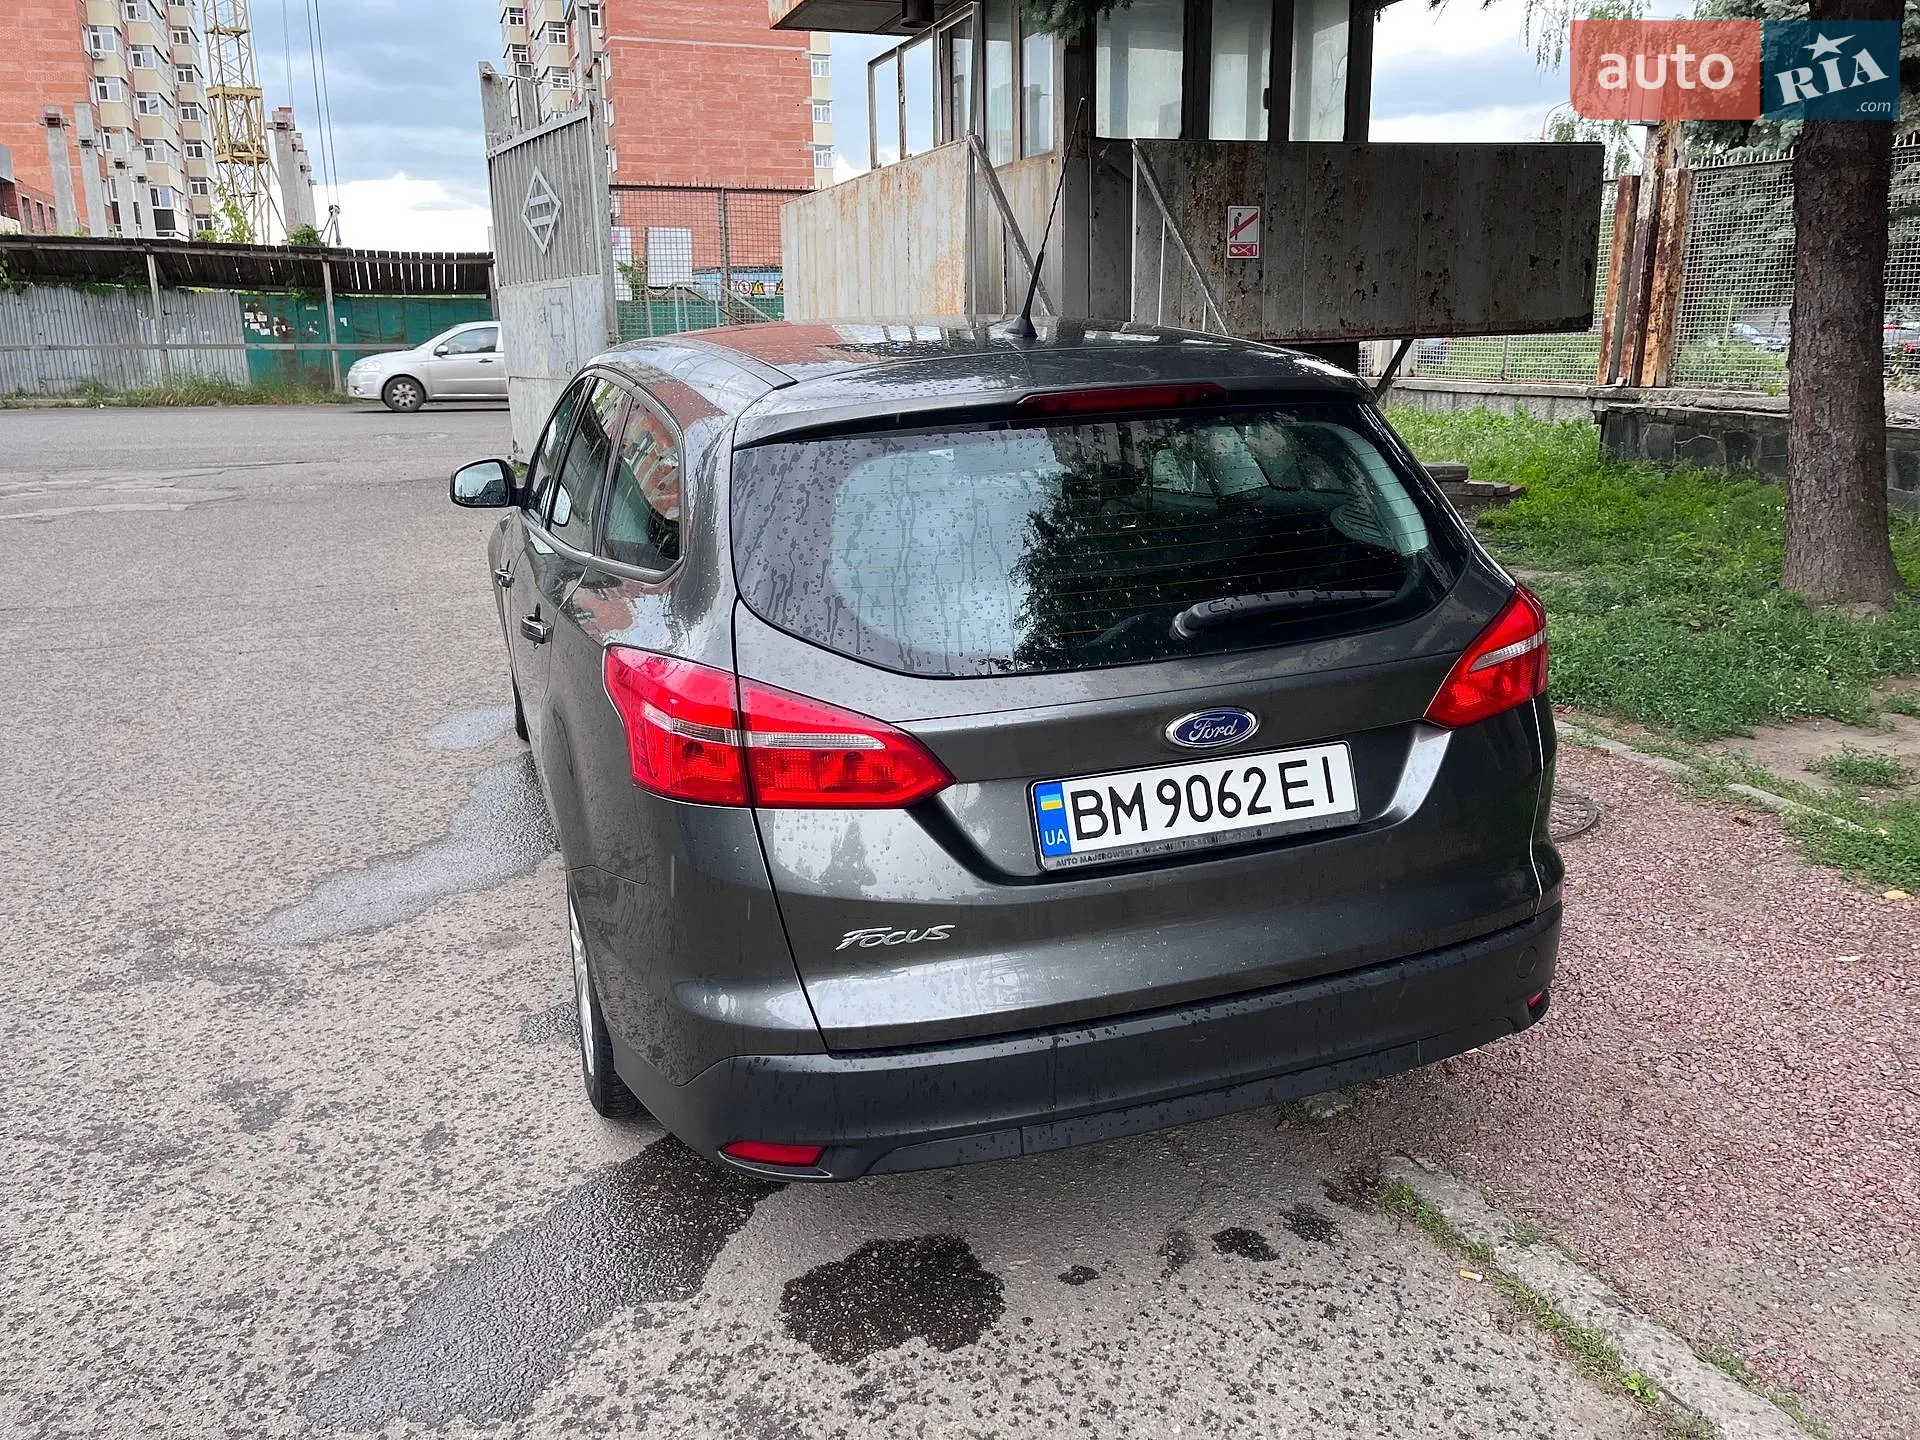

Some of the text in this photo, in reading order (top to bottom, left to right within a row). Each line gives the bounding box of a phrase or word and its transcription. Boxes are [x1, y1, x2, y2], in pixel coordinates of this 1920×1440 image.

[1188, 716, 1238, 742] Ford
[1156, 766, 1272, 828] 9062
[1045, 829, 1068, 846] UA
[1056, 857, 1078, 868] AUTO
